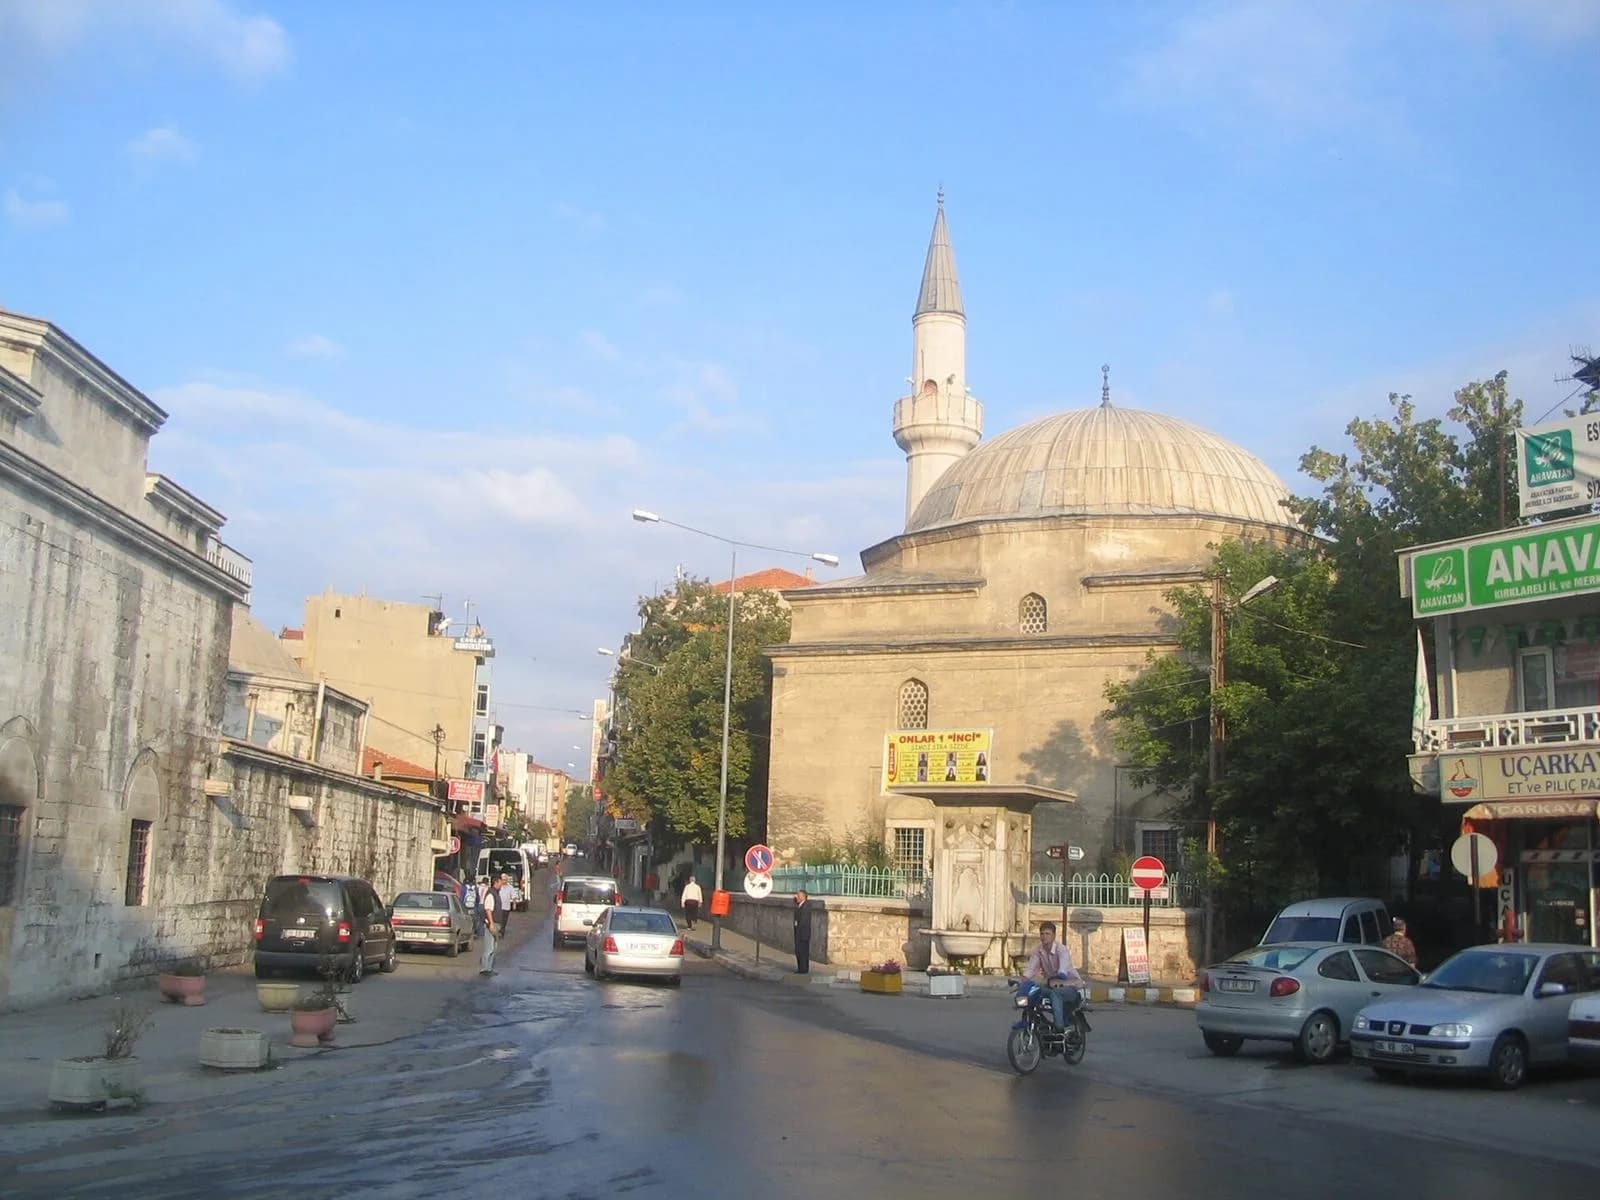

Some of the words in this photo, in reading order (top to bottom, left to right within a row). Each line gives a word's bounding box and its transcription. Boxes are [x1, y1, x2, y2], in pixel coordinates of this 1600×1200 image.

[1586, 421, 1600, 442] ES
[1530, 468, 1573, 483] ANAVATAN
[1485, 533, 1600, 586] ANAV
[1420, 592, 1465, 609] ANAVATAN
[899, 735, 936, 744] ONLAR
[1500, 751, 1600, 782] UÇARKA
[1507, 782, 1523, 794] ET
[1527, 783, 1541, 793] ve
